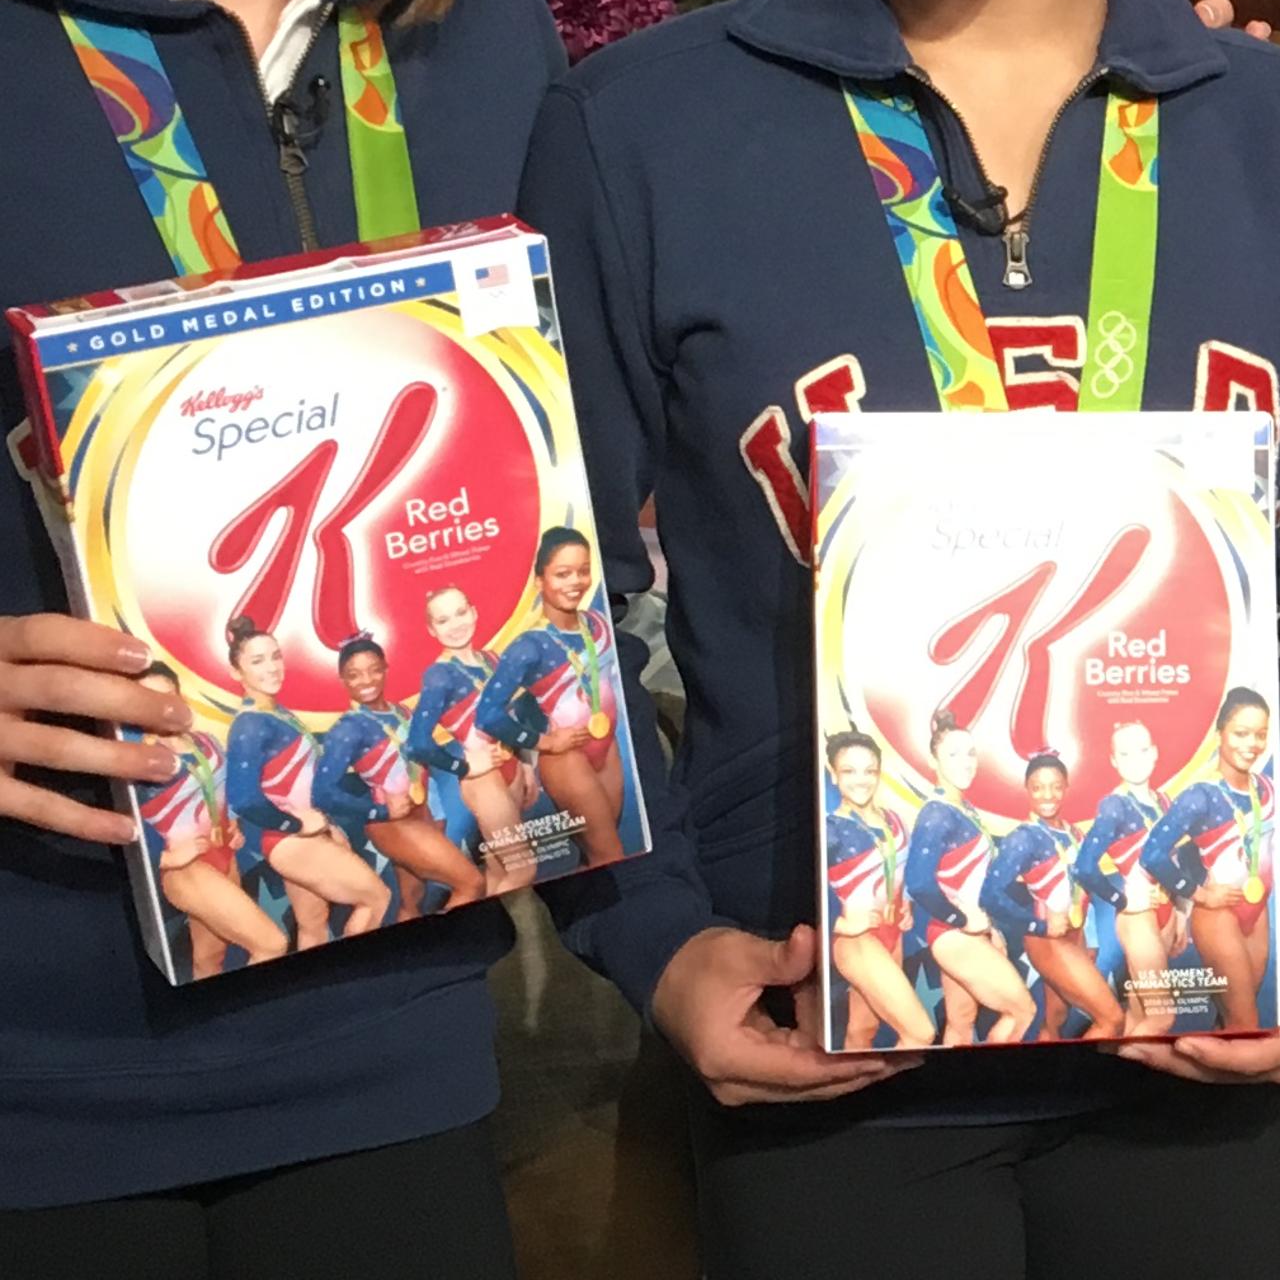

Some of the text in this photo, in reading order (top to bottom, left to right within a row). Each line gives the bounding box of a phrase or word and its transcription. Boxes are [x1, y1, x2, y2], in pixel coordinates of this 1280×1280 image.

[89, 277, 406, 351] GOLD MEDAL EDITION
[180, 384, 265, 417] Kellogg's
[191, 391, 340, 462] Special
[208, 380, 439, 652] K
[405, 486, 470, 527] Red
[384, 517, 500, 560] Berries
[1107, 629, 1167, 658] Red
[1085, 657, 1191, 686] Berries
[554, 816, 586, 830] TEAM
[1124, 977, 1228, 990] GYMNASTICS TEAM
[1159, 968, 1213, 978] WOMEN'S
